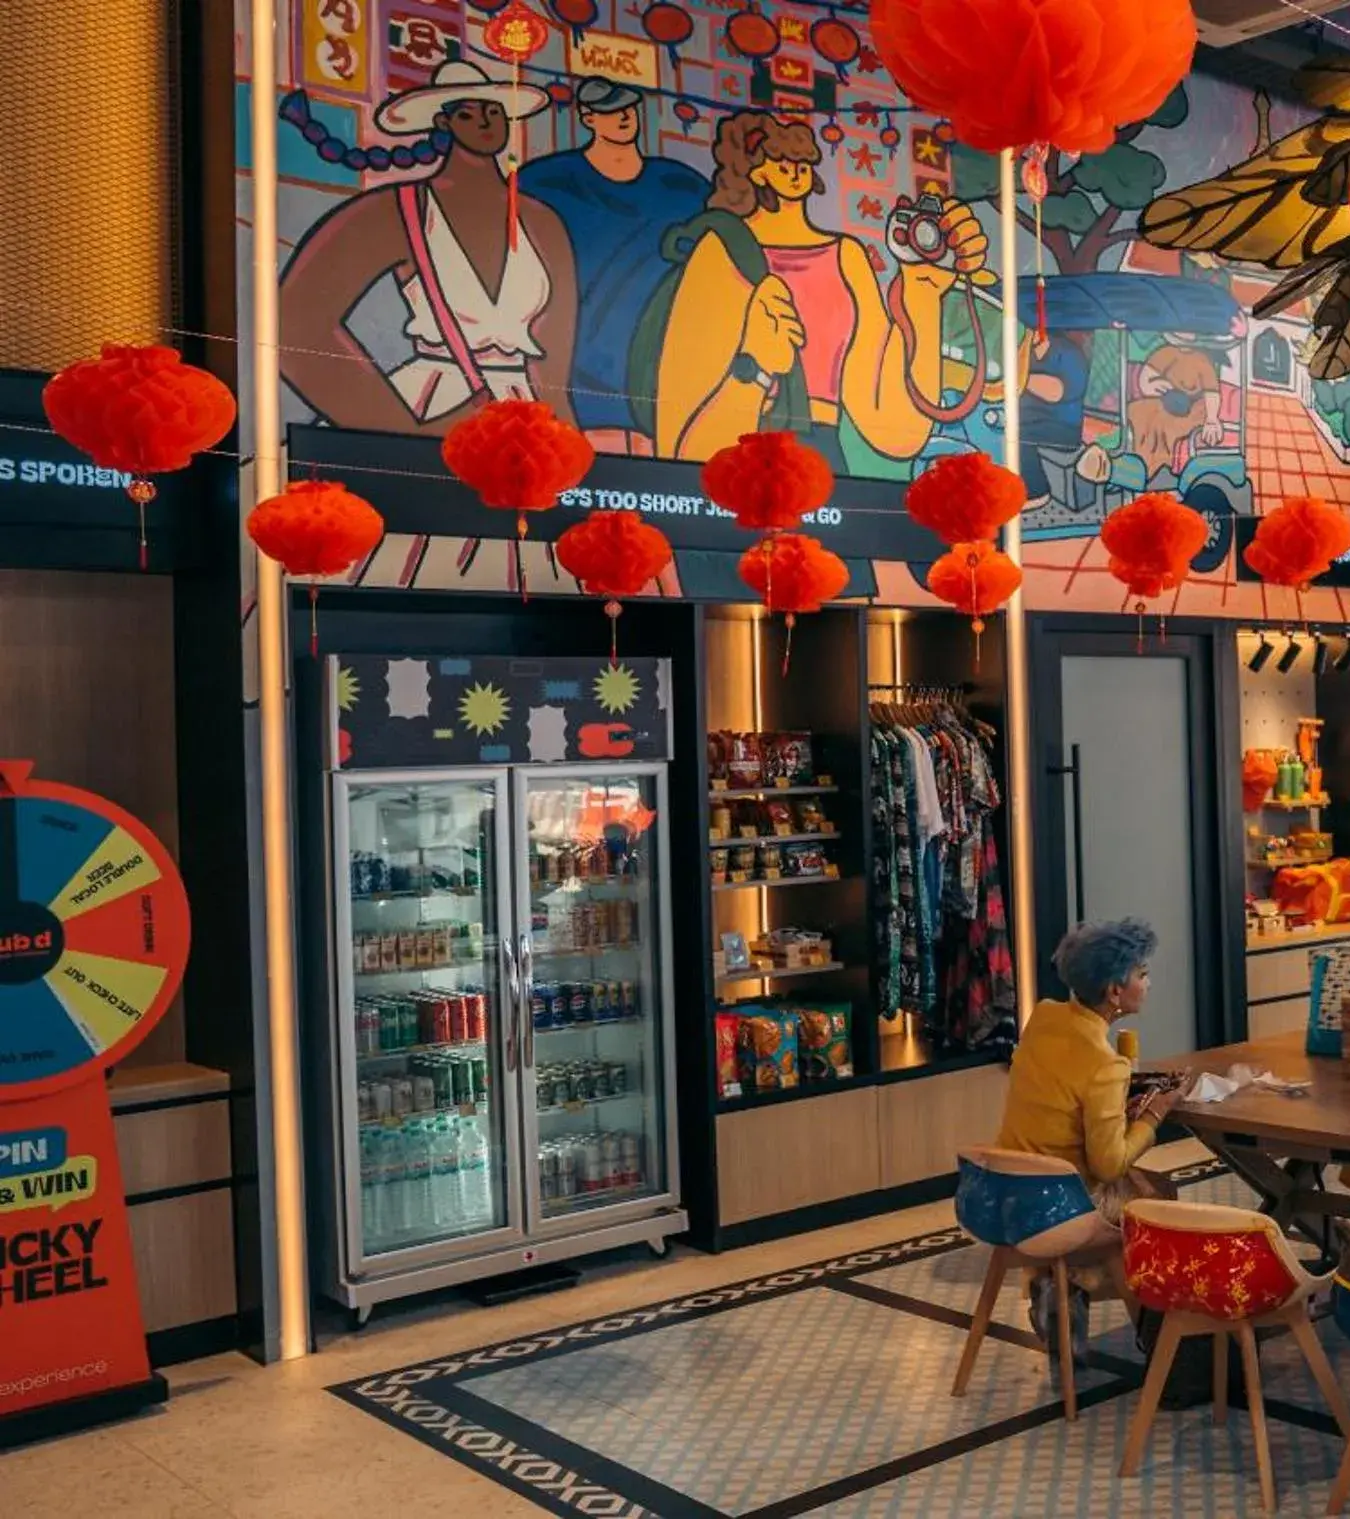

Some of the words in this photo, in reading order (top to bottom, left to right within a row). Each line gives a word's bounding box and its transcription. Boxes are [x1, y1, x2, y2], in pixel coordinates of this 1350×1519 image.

[20, 460, 132, 488] SPOKEN
[595, 489, 638, 510] TOO
[640, 493, 704, 516] SHORT
[817, 507, 842, 525] GO
[21, 1169, 88, 1199] WIN
[0, 1360, 107, 1396] experience
